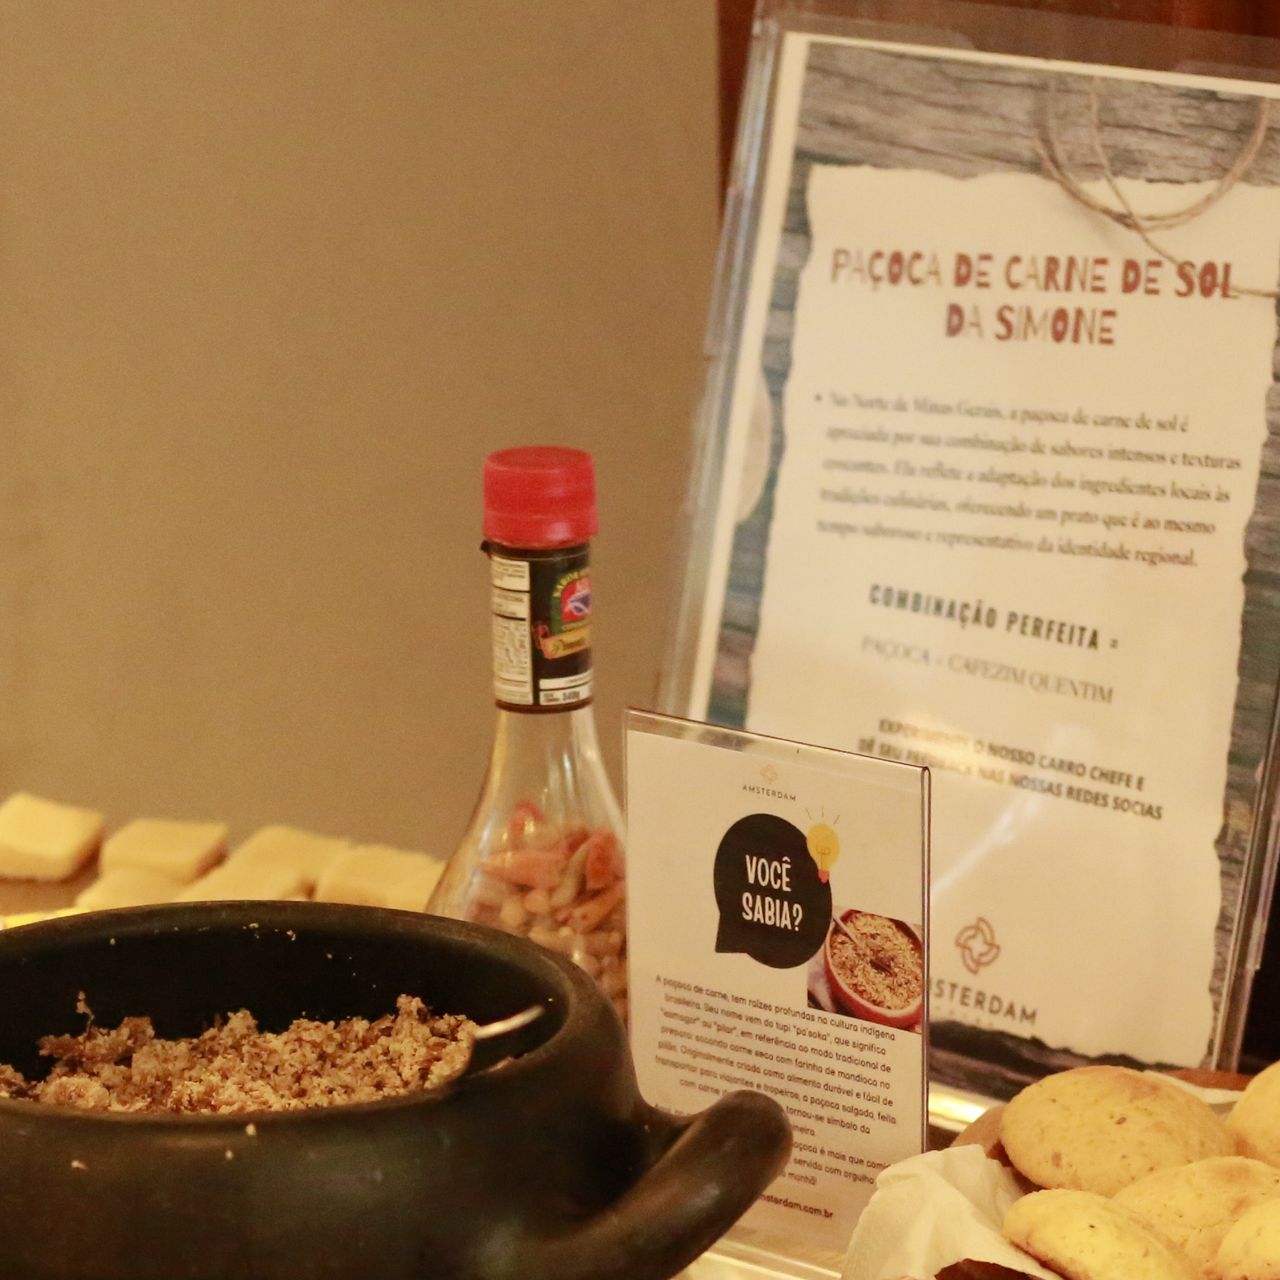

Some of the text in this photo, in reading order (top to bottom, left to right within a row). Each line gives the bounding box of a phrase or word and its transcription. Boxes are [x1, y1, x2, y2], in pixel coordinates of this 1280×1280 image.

[831, 248, 1240, 298] PAÇOCA DE CARNE DE SOL
[946, 303, 1117, 345] DA SIMONE
[913, 396, 953, 414] Minas
[1021, 409, 1069, 426] paçoca
[1072, 407, 1089, 426] de
[1092, 415, 1130, 429] carne
[1134, 412, 1151, 431] de
[1156, 414, 1178, 432] sol
[1179, 414, 1189, 433] é
[944, 433, 1027, 454] combinação
[1030, 435, 1046, 454] de
[1050, 440, 1103, 459] sabores
[1107, 442, 1166, 463] intensos
[1170, 454, 1178, 466] e
[1181, 452, 1241, 470] texturas
[978, 465, 1048, 489] adaptação
[1051, 471, 1075, 490] dos
[1079, 472, 1167, 498] ingredientes
[1170, 480, 1211, 501] locais
[1214, 483, 1231, 503] às
[1035, 508, 1058, 520] um
[1060, 509, 1098, 527] prato
[1102, 514, 1127, 531] que
[1131, 511, 1140, 529] é
[1143, 516, 1161, 530] ao
[1164, 518, 1216, 535] mesmo
[935, 531, 1035, 550] representativo
[1037, 536, 1053, 553] da
[1057, 536, 1130, 561] identidade
[1134, 547, 1198, 568] regional.
[868, 583, 997, 629] COMBINAÇÃO
[1006, 610, 1099, 651] PERFEITA
[861, 635, 1114, 704] PAÇOCA CAFEZIM QUENTIM
[974, 739, 983, 753] O
[987, 744, 1036, 767] NOSSO
[1038, 754, 1086, 777] CARRO
[1089, 766, 1133, 789] CHEFE
[1136, 776, 1145, 791] E
[742, 784, 797, 802] AMSTERDAM
[978, 766, 1005, 785] NAS
[1008, 773, 1063, 798] NOSSAS
[1066, 786, 1109, 808] REDES
[1111, 795, 1164, 821] SOCIAS
[745, 854, 792, 892] VOCÊ
[741, 892, 803, 932] SABIA?
[663, 977, 693, 991] paçoca
[693, 984, 704, 994] de
[705, 989, 729, 1002] carne,
[731, 993, 747, 1005] tem
[748, 998, 773, 1012] raízes
[774, 1005, 816, 1022] profundas
[817, 1015, 828, 1025] na
[830, 1018, 858, 1032] cultura
[860, 1023, 896, 1041] indígena
[703, 1002, 719, 1014] Seu
[721, 1008, 743, 1020] nome
[745, 1014, 762, 1025] vem
[764, 1018, 774, 1028] do
[776, 1020, 791, 1033] tupi
[834, 1035, 850, 1047] que
[852, 1039, 886, 1055] significa
[695, 1035, 729, 1049] socando
[729, 1043, 753, 1056] carne
[754, 1049, 774, 1061] seca
[775, 1054, 793, 1065] com
[794, 1057, 823, 1073] farinha
[824, 1066, 836, 1076] de
[837, 1070, 878, 1088] mandioca
[880, 1080, 891, 1090] no
[702, 1019, 712, 1029] ou
[740, 1030, 753, 1039] em
[755, 1033, 797, 1050] referência
[798, 1044, 809, 1054] ao
[810, 1046, 834, 1059] modo
[835, 1051, 879, 1070] tradicional
[880, 1063, 892, 1073] de
[679, 1078, 696, 1087] com
[698, 1083, 720, 1094] carne
[680, 1044, 735, 1068] Originalmente
[763, 1068, 785, 1080] como
[786, 1073, 822, 1089] alimento
[823, 1081, 854, 1097] durável
[862, 1090, 881, 1105] fácil
[882, 1096, 894, 1107] de
[700, 1067, 718, 1079] para
[719, 1073, 754, 1088] viajantes
[810, 1096, 840, 1110] paçoca
[841, 1104, 876, 1120] salgada,
[877, 1111, 897, 1125] feita
[786, 1105, 871, 1134] tornou-se símbolo da
[794, 1141, 864, 1166] açoca é mais que
[824, 1165, 842, 1177] com
[843, 1170, 875, 1185] orgulho
